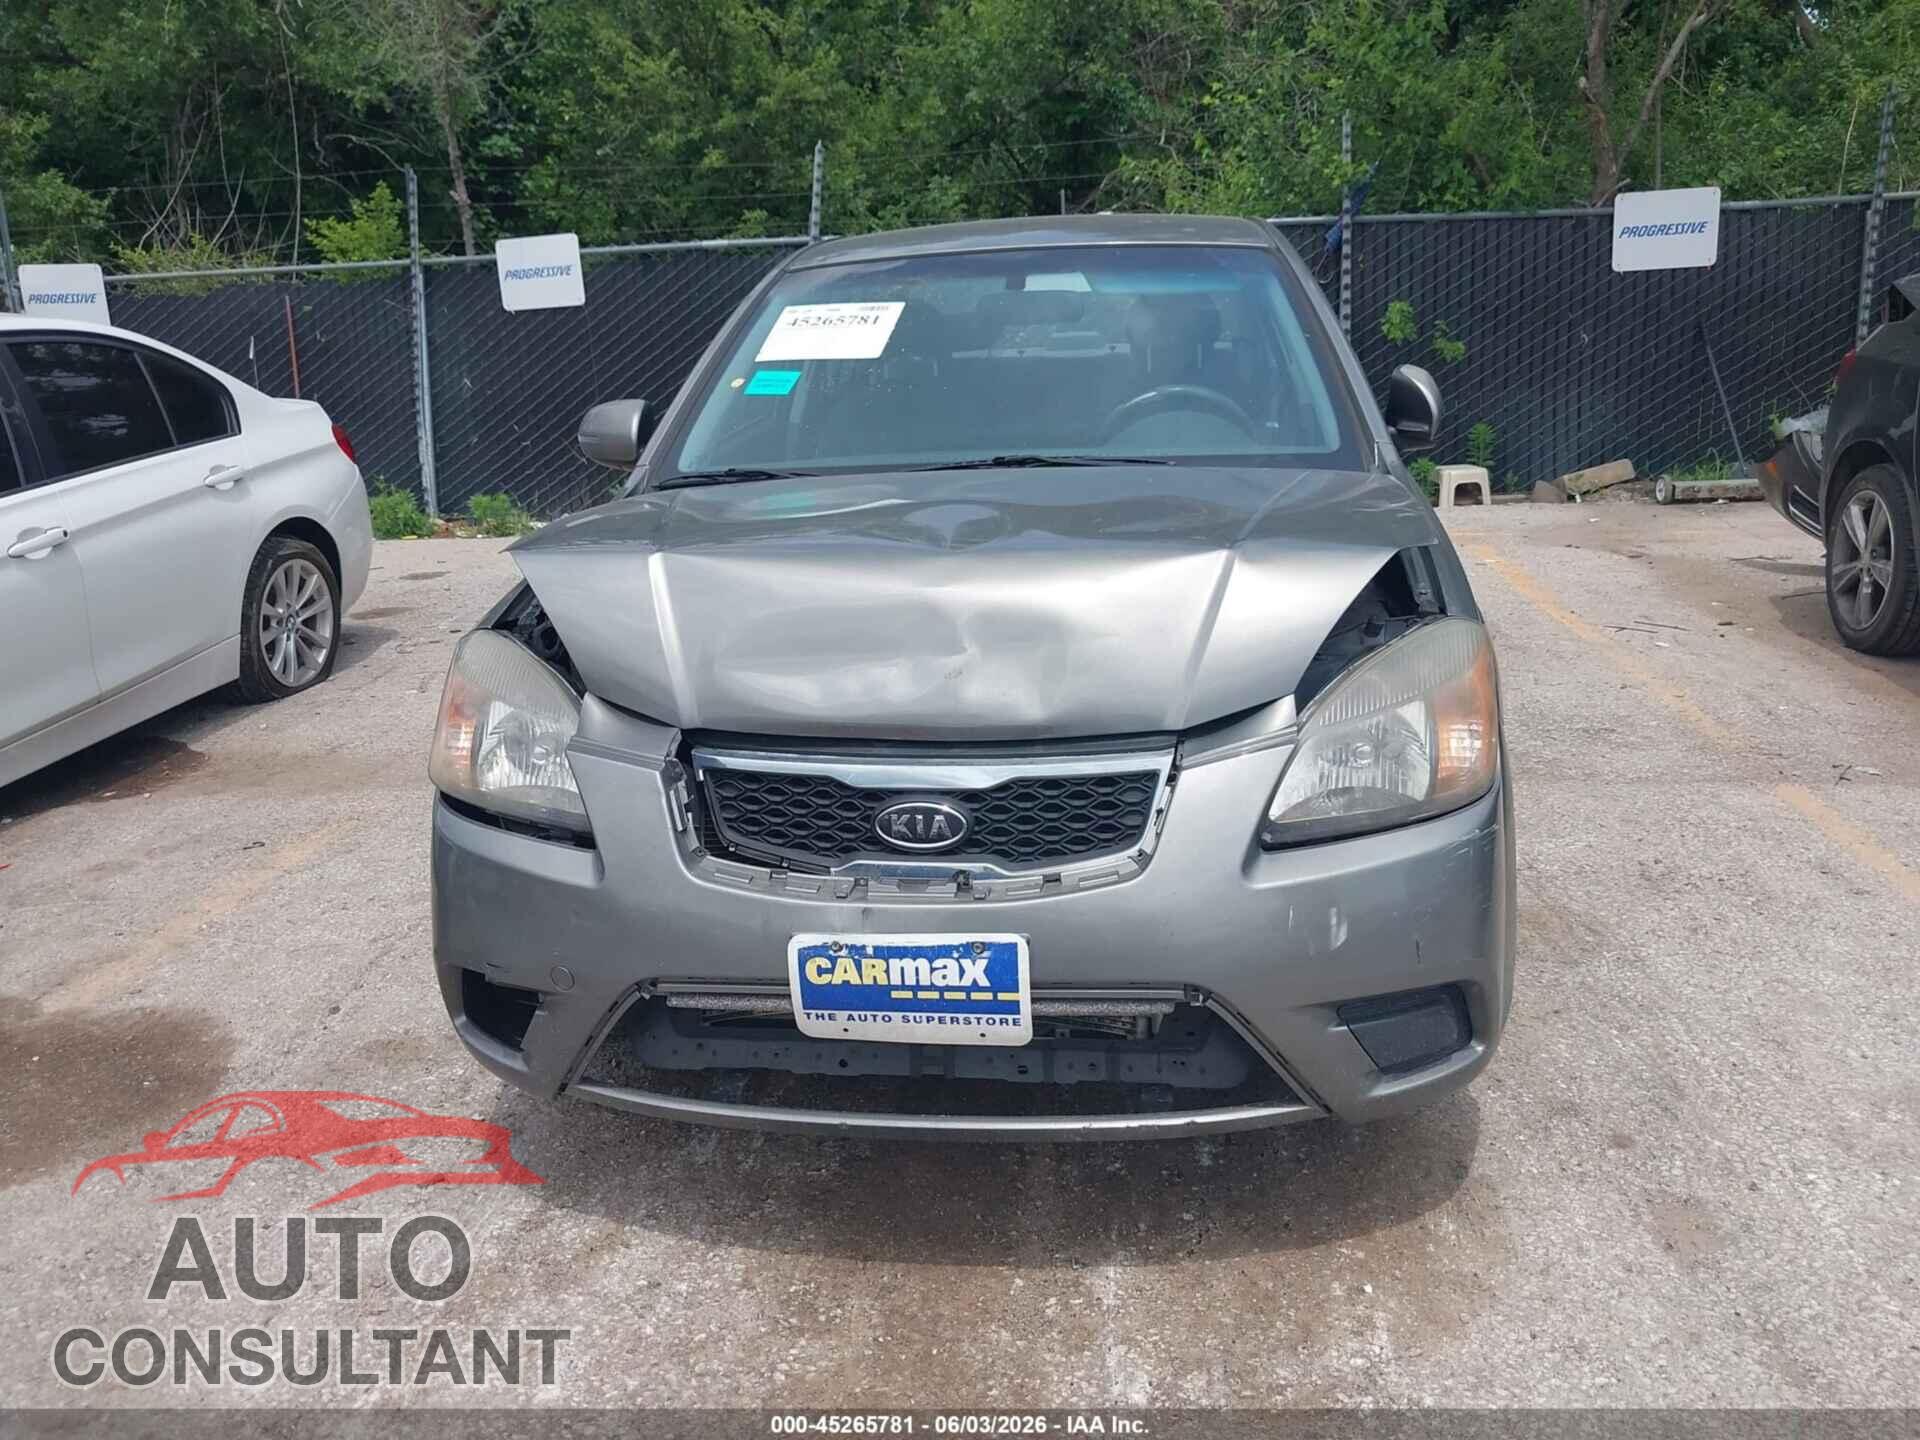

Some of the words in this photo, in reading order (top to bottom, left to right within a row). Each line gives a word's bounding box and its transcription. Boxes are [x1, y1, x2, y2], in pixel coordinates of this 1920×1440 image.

[1619, 221, 1709, 239] PROGRESSIVE
[504, 264, 573, 281] PROGRESSIVE
[28, 292, 97, 304] PROGRESSIVE
[786, 314, 880, 328] 45265781
[889, 813, 953, 839] KIA
[803, 1011, 837, 1022] THE
[846, 1013, 893, 1024] AUTO
[901, 1014, 1022, 1028] SUPERSTORE
